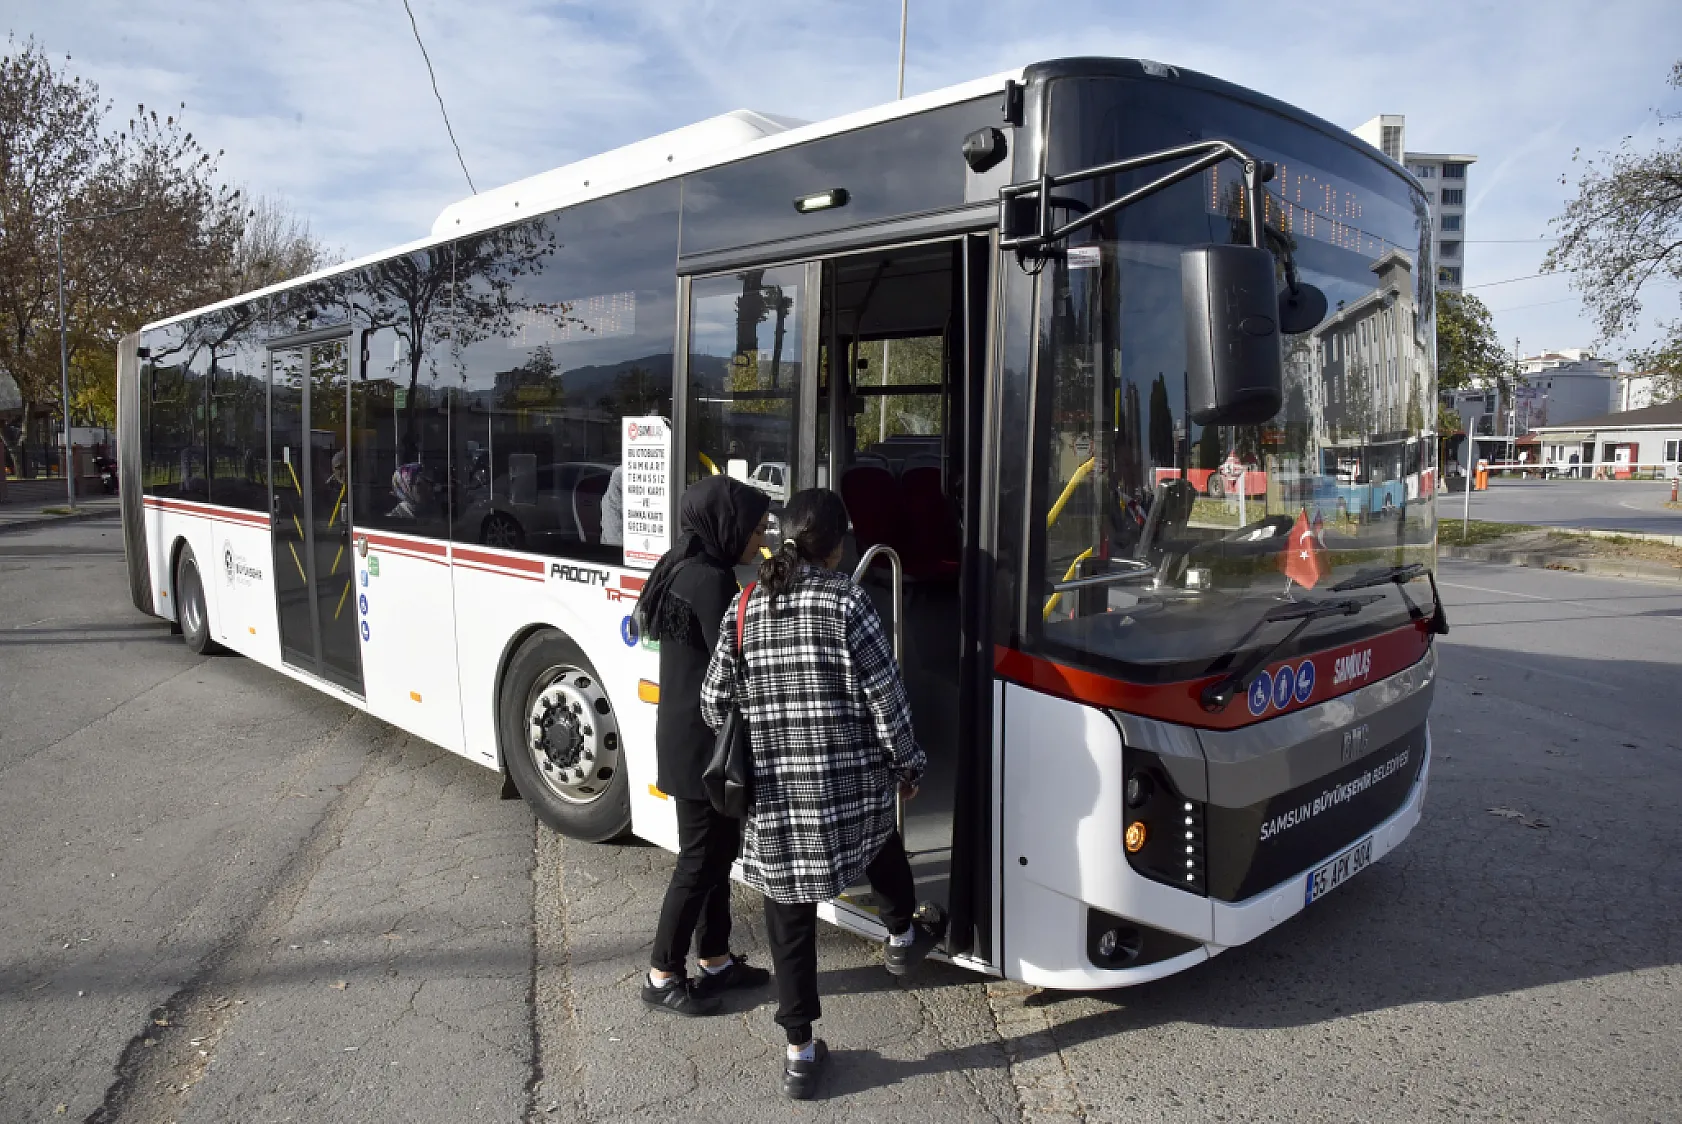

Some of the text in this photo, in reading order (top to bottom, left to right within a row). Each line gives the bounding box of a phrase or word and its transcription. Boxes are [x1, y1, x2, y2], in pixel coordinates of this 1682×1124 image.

[551, 563, 610, 587] PROCITY
[1260, 802, 1312, 841] SAMSUN
[1312, 769, 1372, 817] BÜYÜKŞEHİR
[1312, 868, 1327, 897] 55
[1329, 852, 1352, 888] APK
